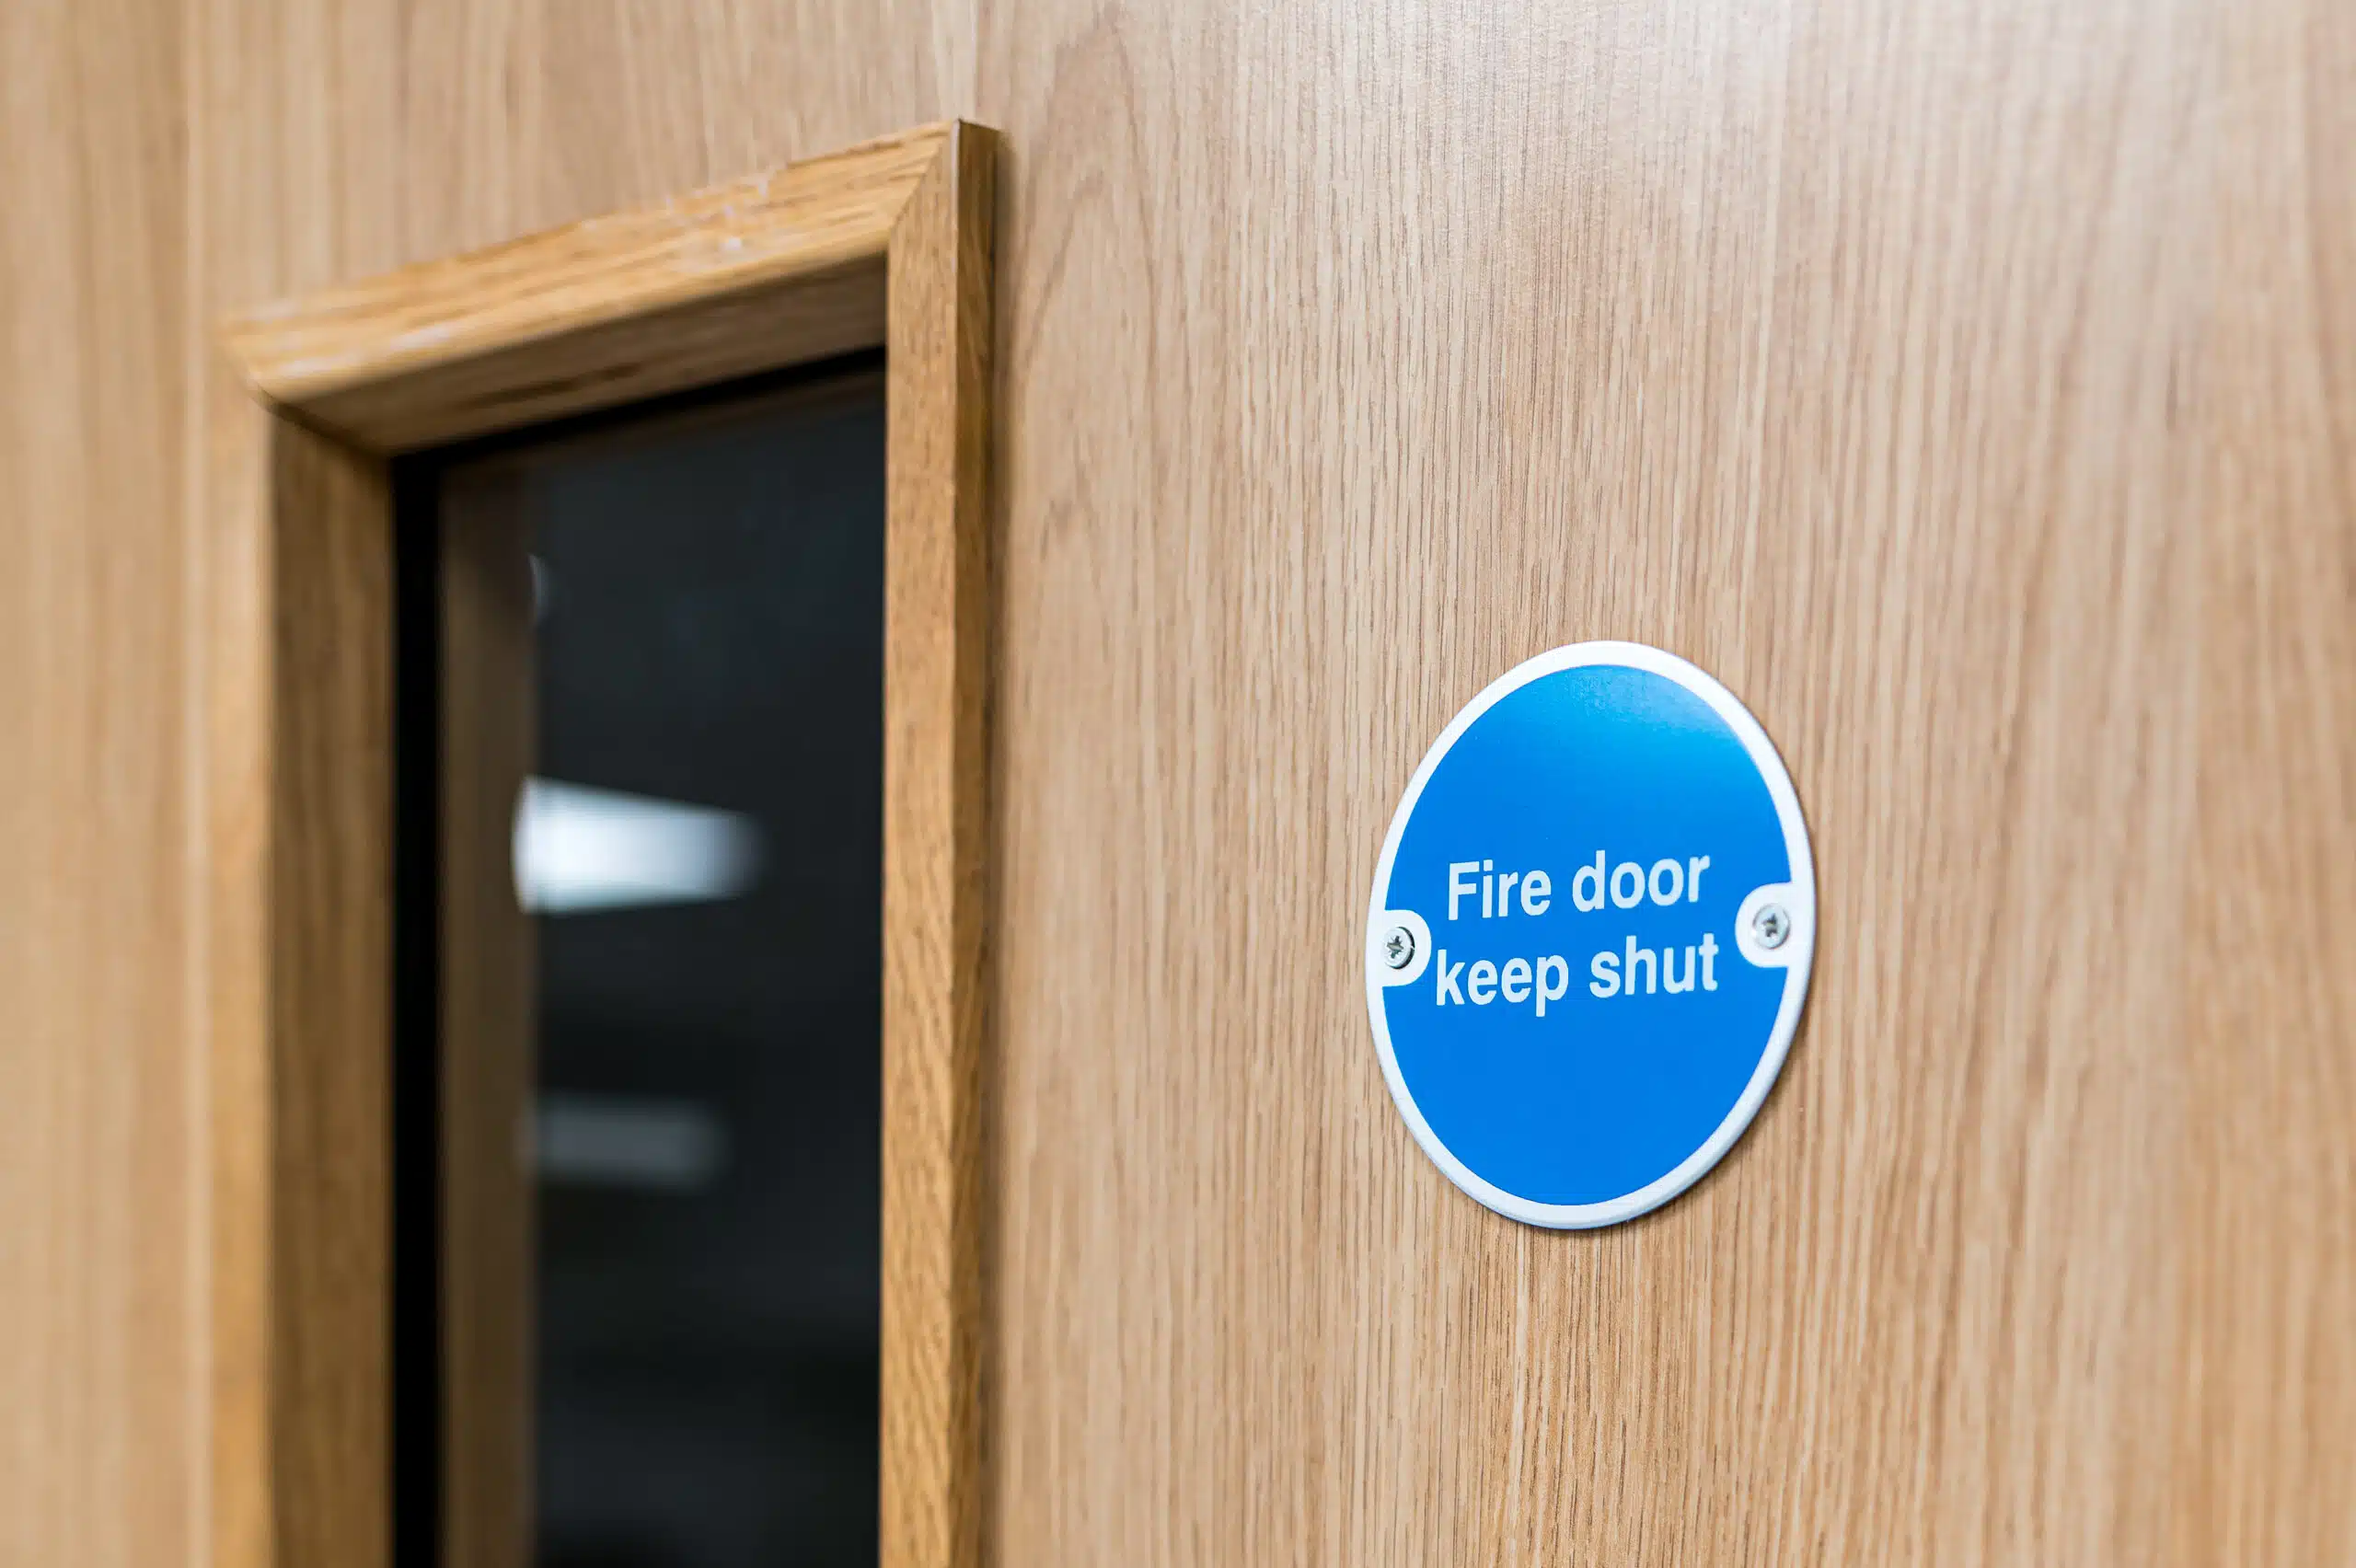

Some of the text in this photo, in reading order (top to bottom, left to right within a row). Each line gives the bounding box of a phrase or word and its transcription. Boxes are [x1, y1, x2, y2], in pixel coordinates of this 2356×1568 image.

[1448, 849, 1711, 921] Fire door
[1436, 933, 1719, 1018] keep shut
